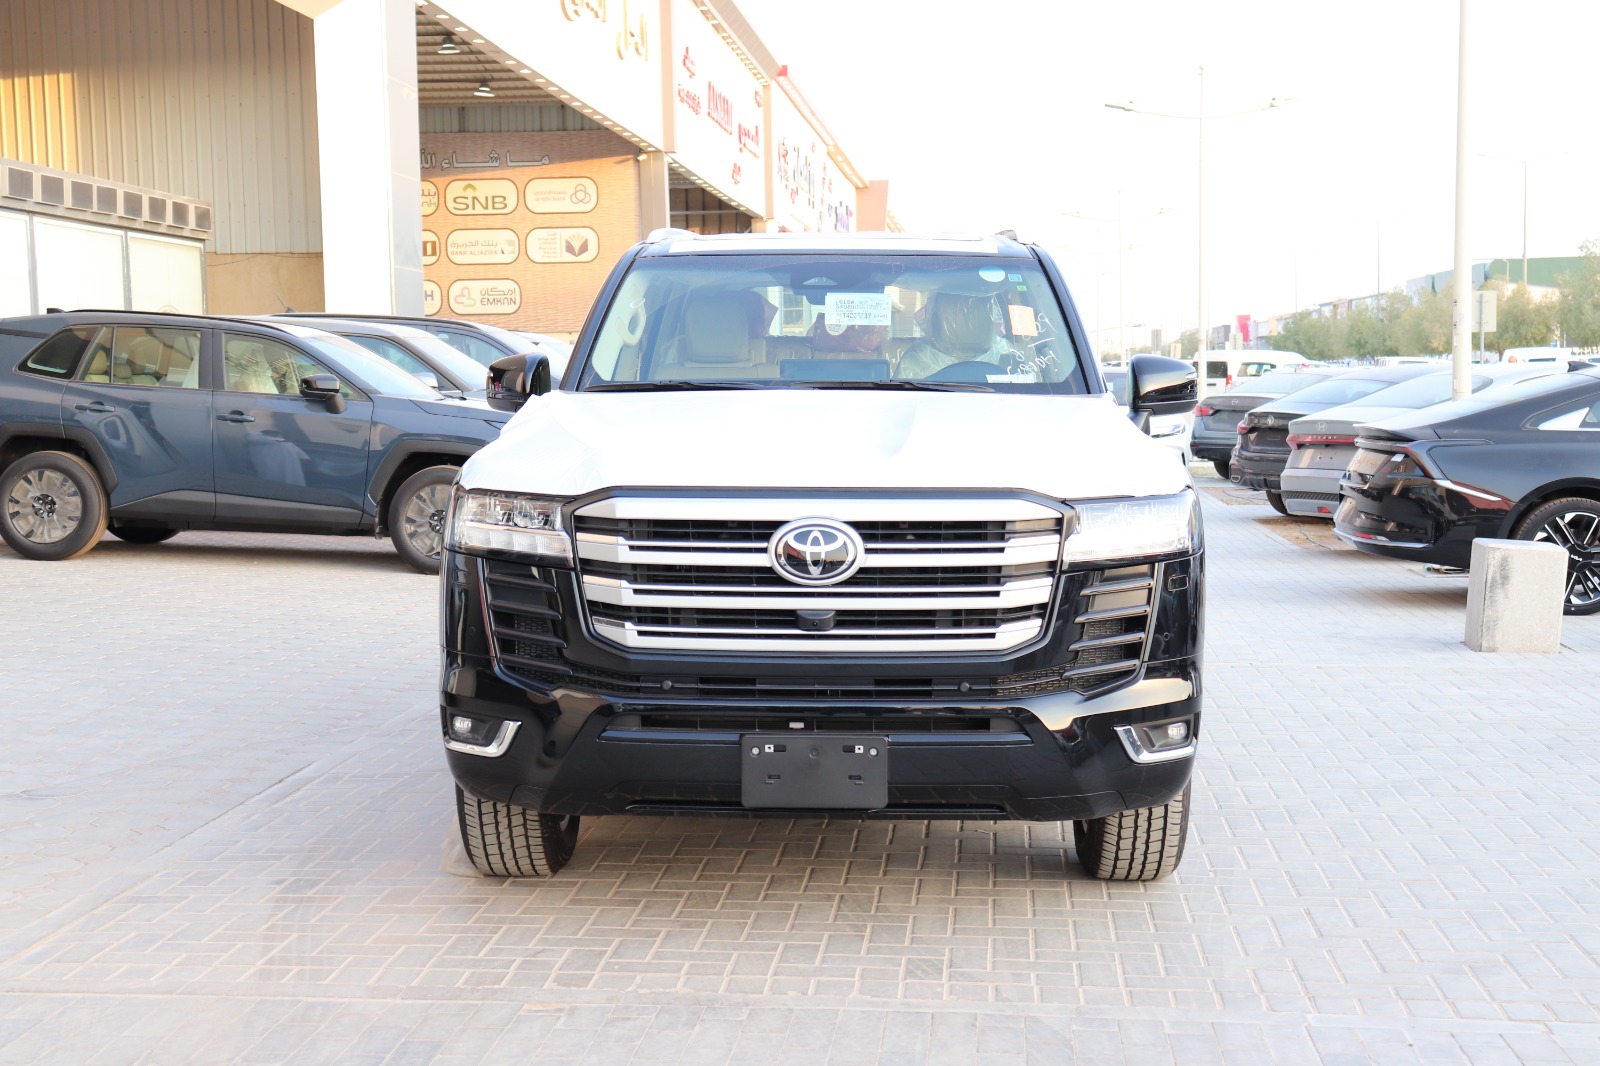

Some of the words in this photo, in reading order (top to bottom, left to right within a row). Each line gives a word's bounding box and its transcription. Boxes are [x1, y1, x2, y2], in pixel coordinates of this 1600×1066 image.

[440, 149, 500, 170] شاء
[506, 149, 550, 167] ما
[453, 195, 508, 211] SNB
[450, 240, 479, 249] الجزيرة
[481, 240, 498, 248] بنك
